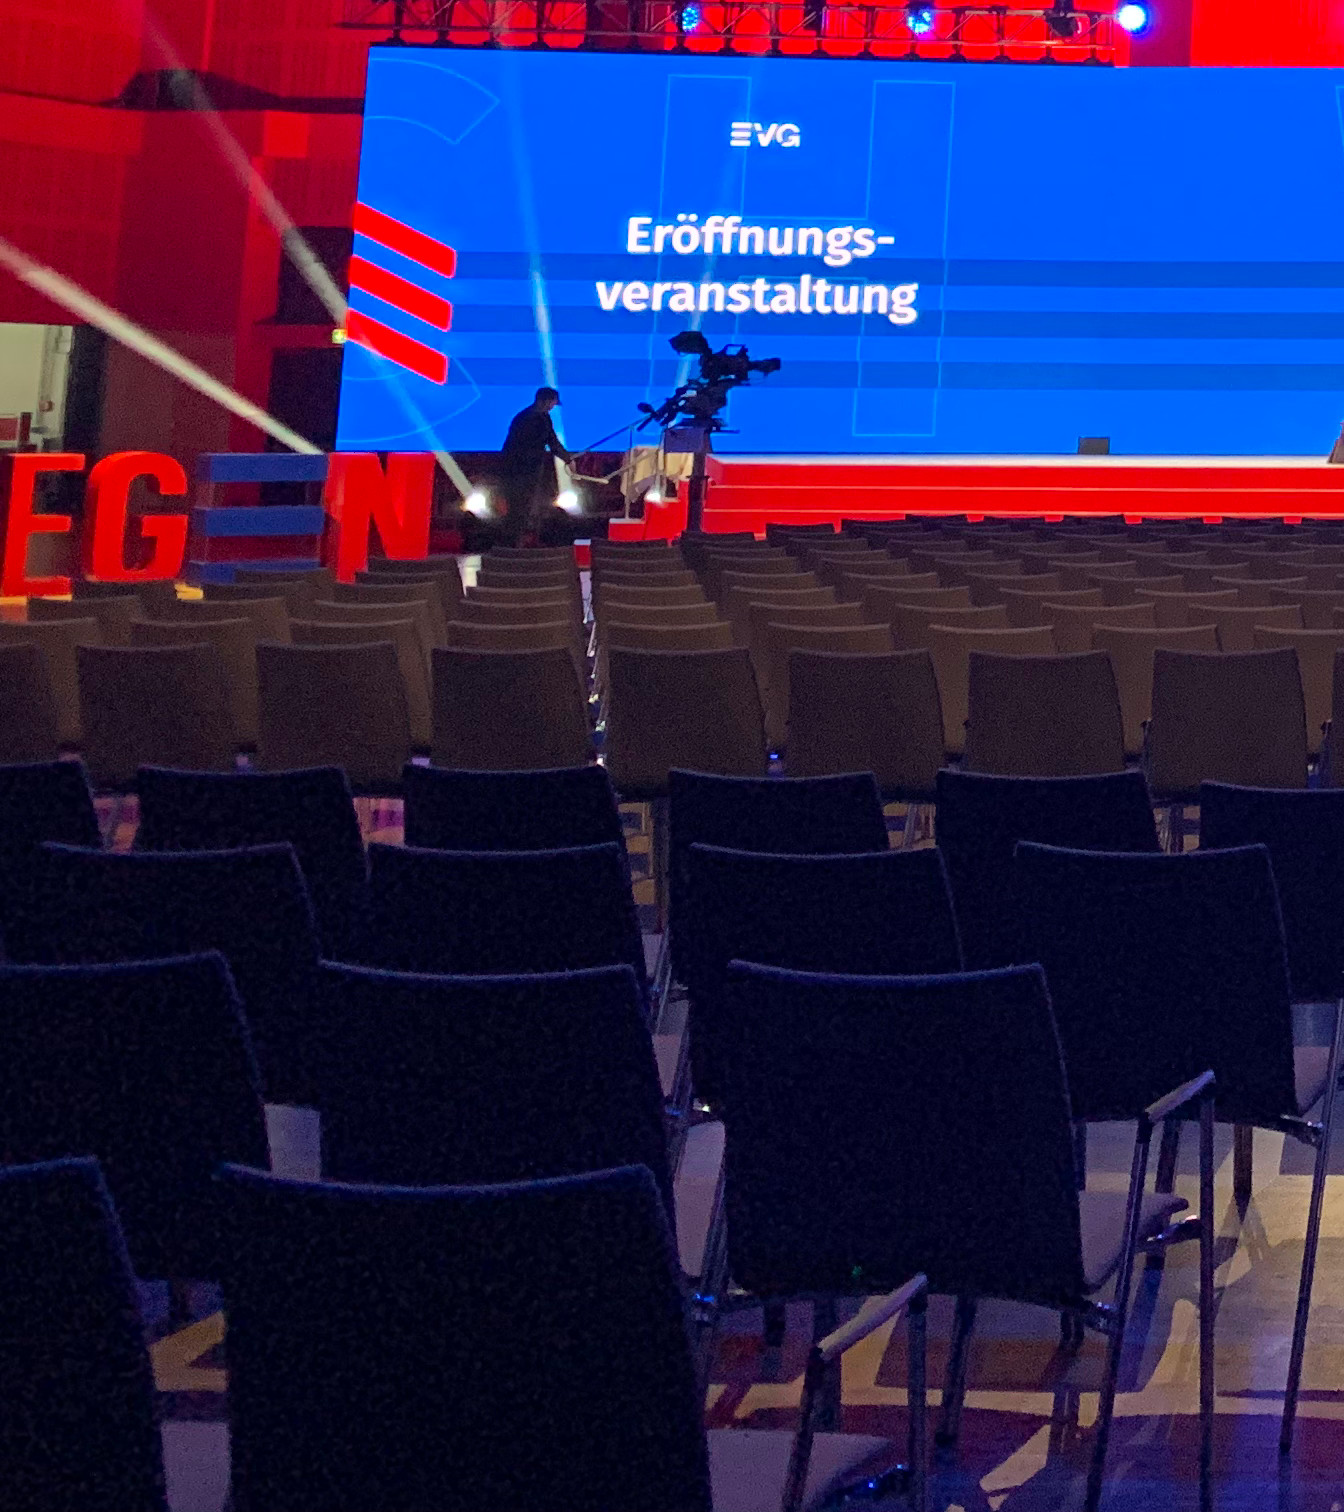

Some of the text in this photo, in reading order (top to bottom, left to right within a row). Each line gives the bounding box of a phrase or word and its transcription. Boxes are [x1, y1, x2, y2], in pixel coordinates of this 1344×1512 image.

[730, 122, 801, 148] EVG
[626, 214, 896, 267] Eröffnungs-
[595, 274, 919, 325] veranstaltung
